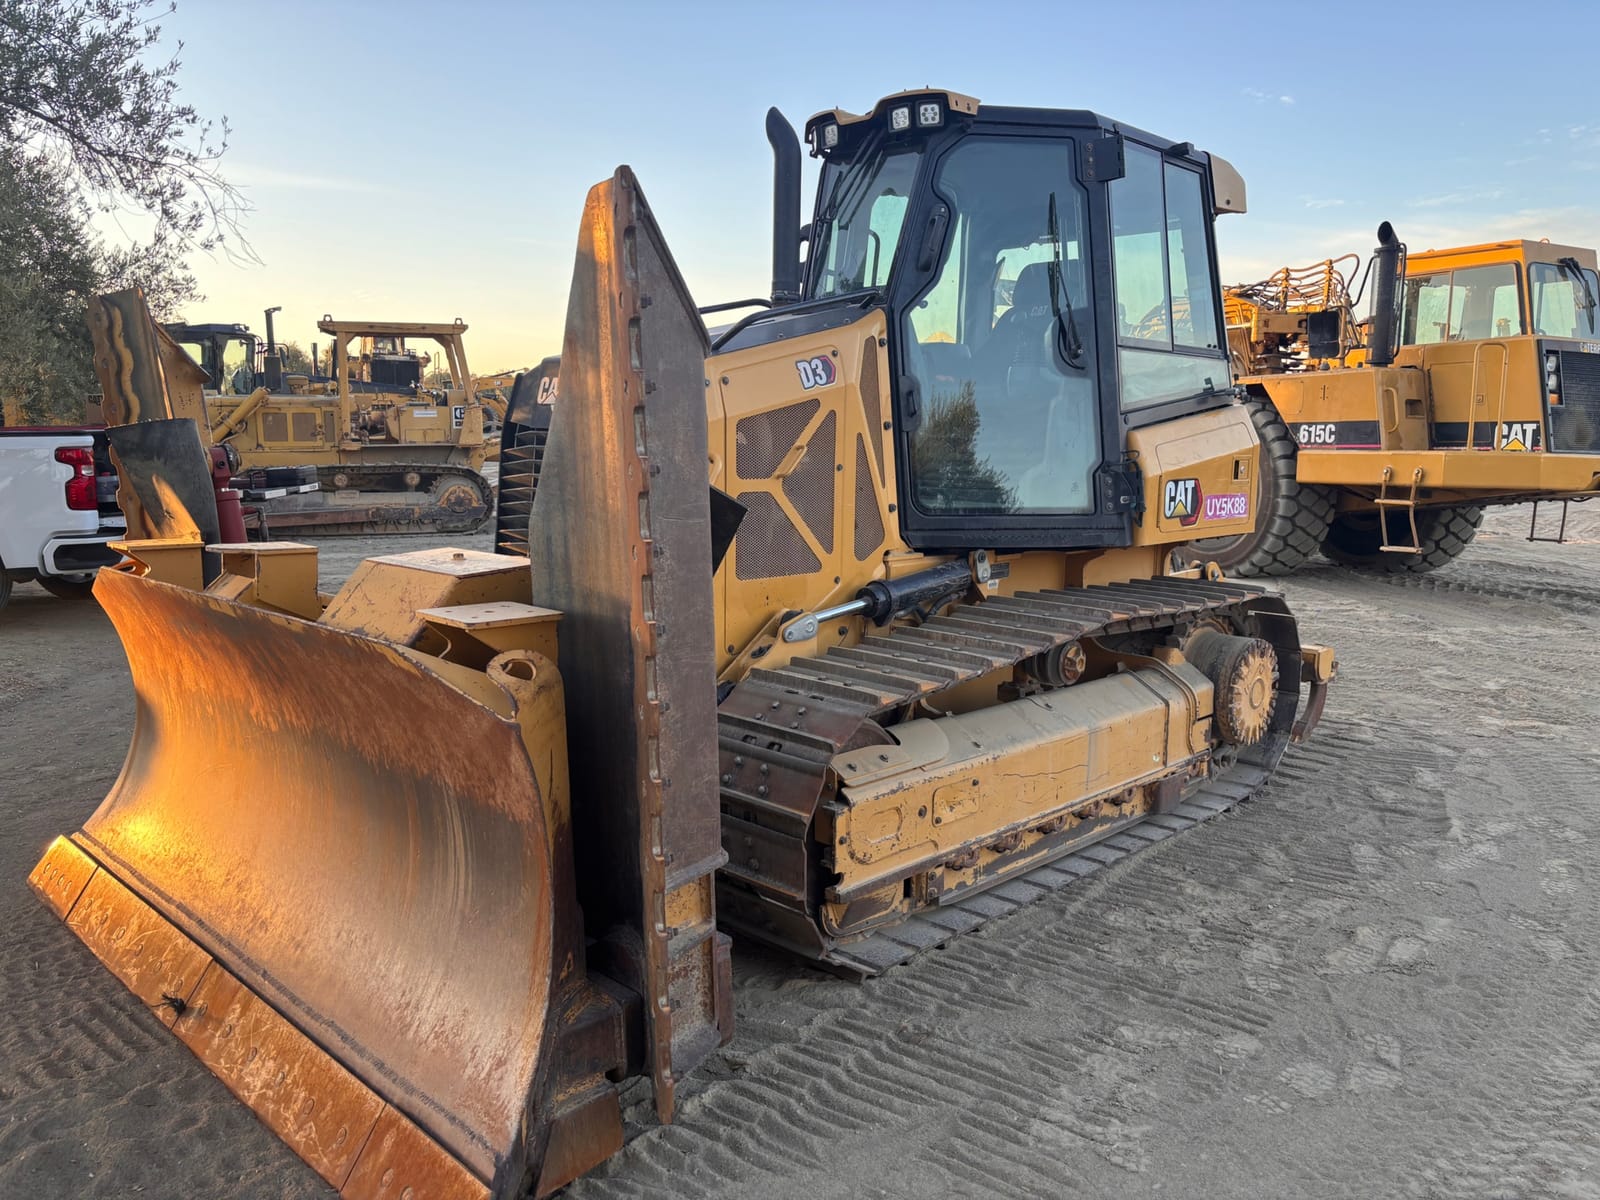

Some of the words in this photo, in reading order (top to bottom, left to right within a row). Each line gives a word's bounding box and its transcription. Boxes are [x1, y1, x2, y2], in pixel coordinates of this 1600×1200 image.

[796, 358, 827, 389] D3
[537, 376, 560, 405] CA
[1299, 423, 1336, 444] 615C
[1493, 423, 1537, 451] CAT
[1165, 479, 1195, 518] CAT
[1206, 496, 1246, 517] UY5K88
